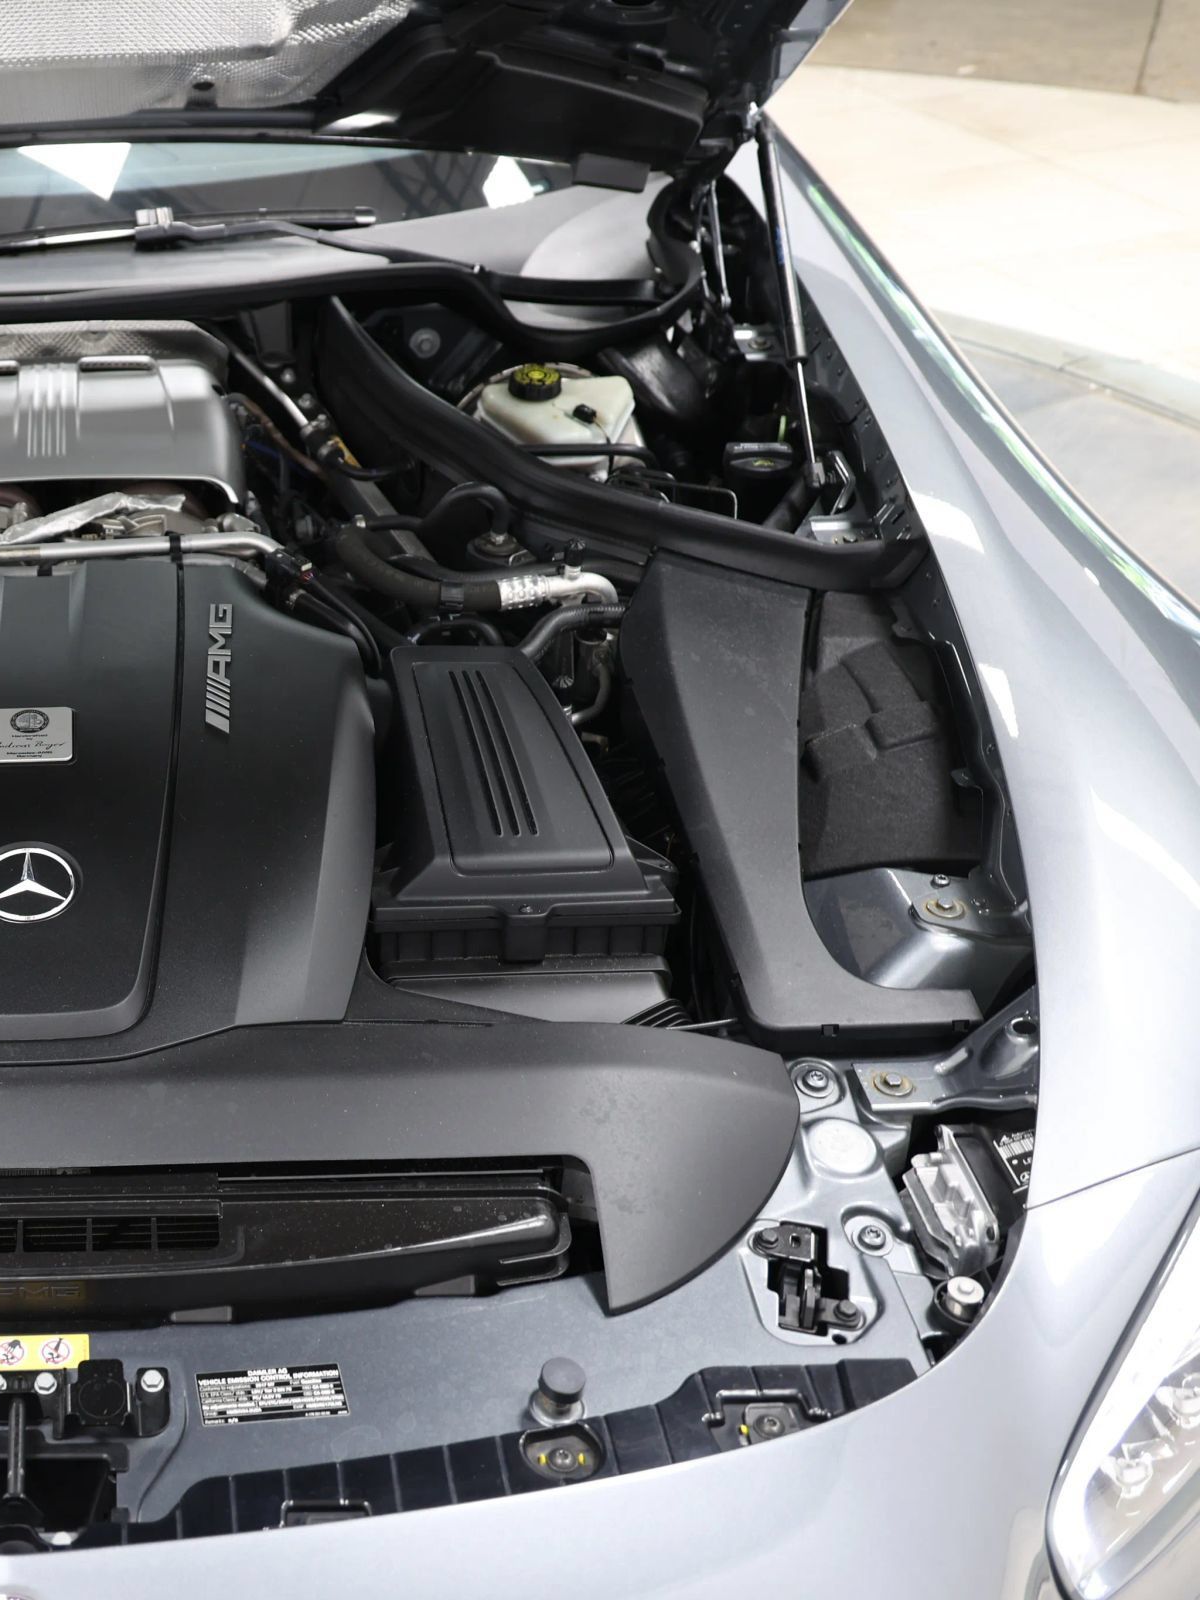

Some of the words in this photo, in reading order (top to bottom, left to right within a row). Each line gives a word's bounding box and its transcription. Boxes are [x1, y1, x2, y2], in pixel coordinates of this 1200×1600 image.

[198, 1378, 227, 1386] VEHICLE
[227, 1375, 260, 1384] EMISSION
[260, 1373, 293, 1382] CONTROL
[292, 1369, 339, 1379] INFORMATION
